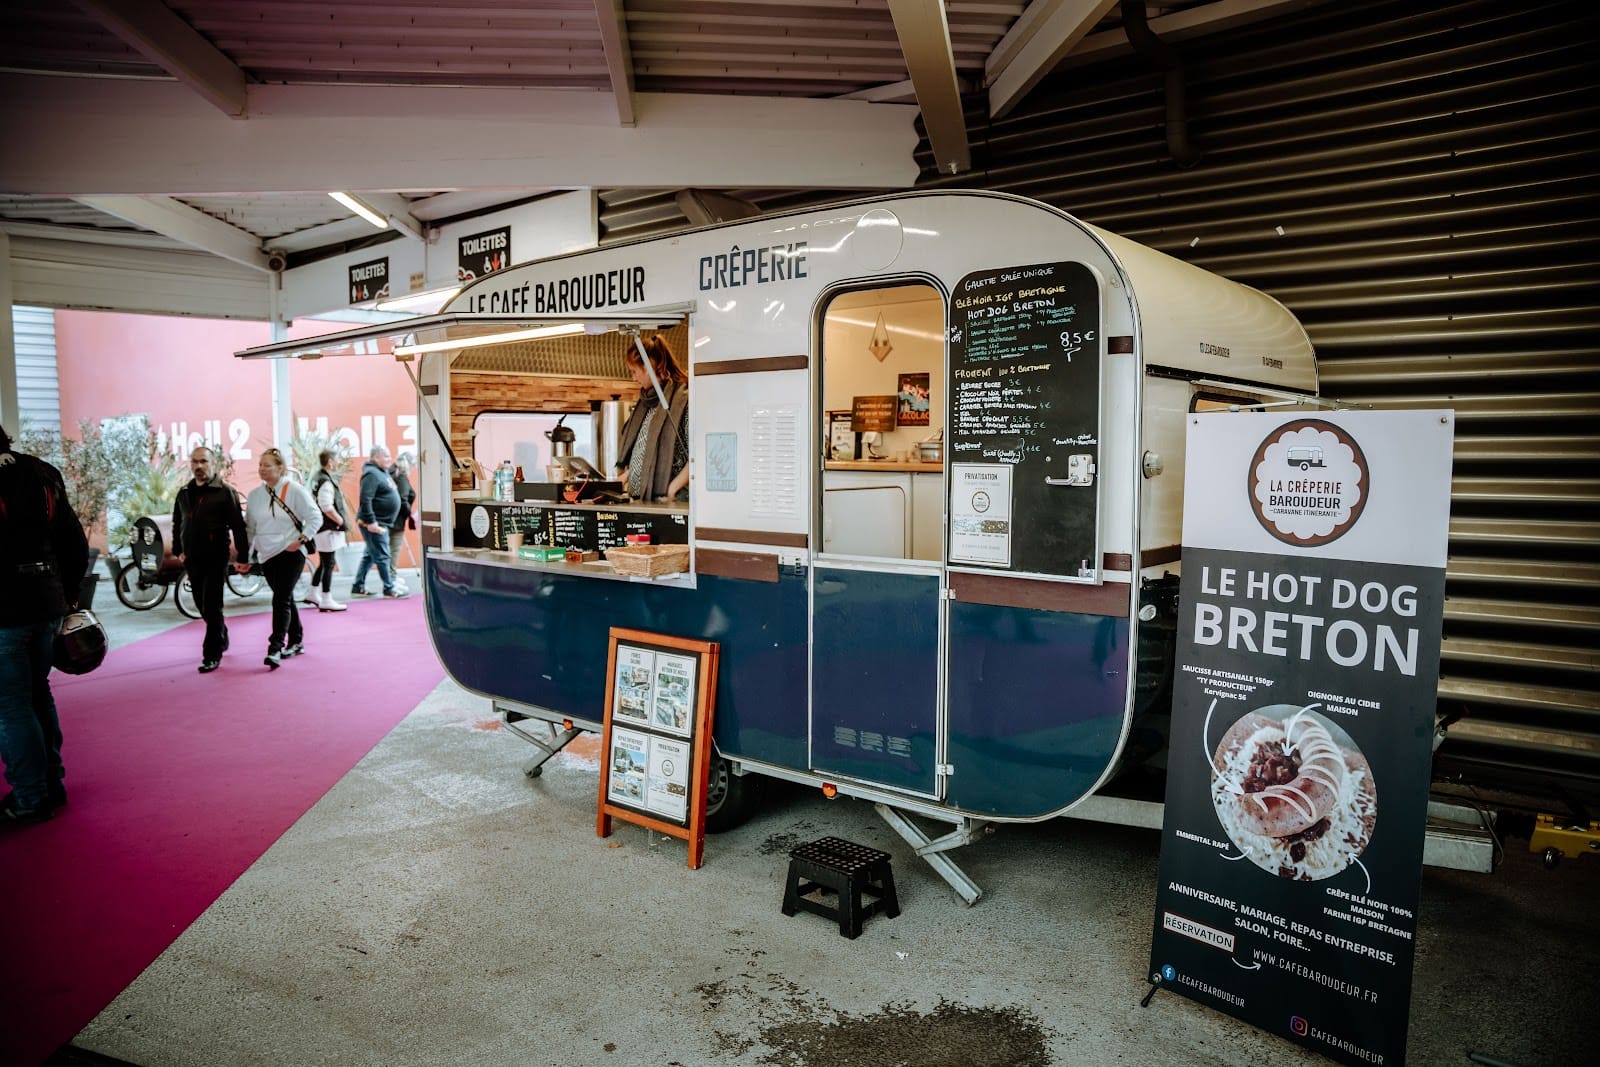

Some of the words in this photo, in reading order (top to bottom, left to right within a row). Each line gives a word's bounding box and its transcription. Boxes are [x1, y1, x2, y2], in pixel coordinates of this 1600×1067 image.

[462, 232, 507, 256] TOILETTES
[352, 262, 386, 282] TOILETTES
[699, 241, 808, 292] CRÊPERIE
[965, 276, 997, 292] GALETTE
[1001, 271, 1021, 283] SALÉE
[1023, 266, 1055, 278] UNIQUE
[470, 294, 488, 313] LE
[491, 280, 530, 313] CAFÉ
[535, 266, 645, 313] BAROUDEUR
[995, 293, 1014, 302] IGP
[1018, 285, 1067, 299] BRETAGNE
[967, 308, 985, 320] HOT
[987, 306, 1009, 318] DOG
[1013, 297, 1056, 313] BRETON
[955, 367, 993, 379] FROMENT
[172, 420, 221, 461] Hall
[228, 418, 252, 460] 2
[965, 472, 998, 481] PRIVATISATION
[1269, 479, 1283, 493] LA
[1287, 478, 1342, 495] CRÊPERIE
[1269, 495, 1341, 509] BAROUDEUR
[1201, 566, 1236, 597] LE
[1246, 570, 1322, 606] HOT
[1332, 578, 1418, 617] DOG
[1193, 602, 1419, 677] BRETON
[1182, 664, 1211, 676] SAUCISSE
[1212, 669, 1254, 683] ARTISANALE
[1254, 676, 1275, 687] 150gr
[1204, 687, 1238, 699] Kervignac
[1238, 693, 1247, 701] 56
[1307, 690, 1344, 703] OIGNONS
[1345, 696, 1357, 705] AU
[1357, 698, 1381, 710] CIDRE
[1326, 704, 1359, 717] MAISON
[1176, 829, 1211, 846] EMMENTAL
[1326, 886, 1350, 902] CRÊPE
[1350, 893, 1366, 905] BLÉ
[1367, 898, 1389, 912] NOIR
[1390, 904, 1413, 918] 100%
[1350, 904, 1385, 921] MAISON
[1164, 916, 1233, 949] RÉSERVATION
[1168, 881, 1239, 914] ANNIVERSAIRE,
[1240, 903, 1288, 930] MARIAGE,
[1290, 921, 1323, 942] REPAS
[1324, 935, 1397, 966] ENTREPRISE,
[1234, 916, 1272, 940] SALON,
[1273, 929, 1311, 952] FOIRE...
[1323, 907, 1352, 922] FARINE
[1352, 914, 1368, 926] IGP
[1367, 919, 1412, 940] BRETAGNE
[1252, 948, 1379, 1005] WWW.CAFEBAROUDEUR.FR
[1177, 972, 1246, 1008] LECAFEBAROUDEUR
[1310, 1026, 1385, 1066] CAFEBAROUDEUR
